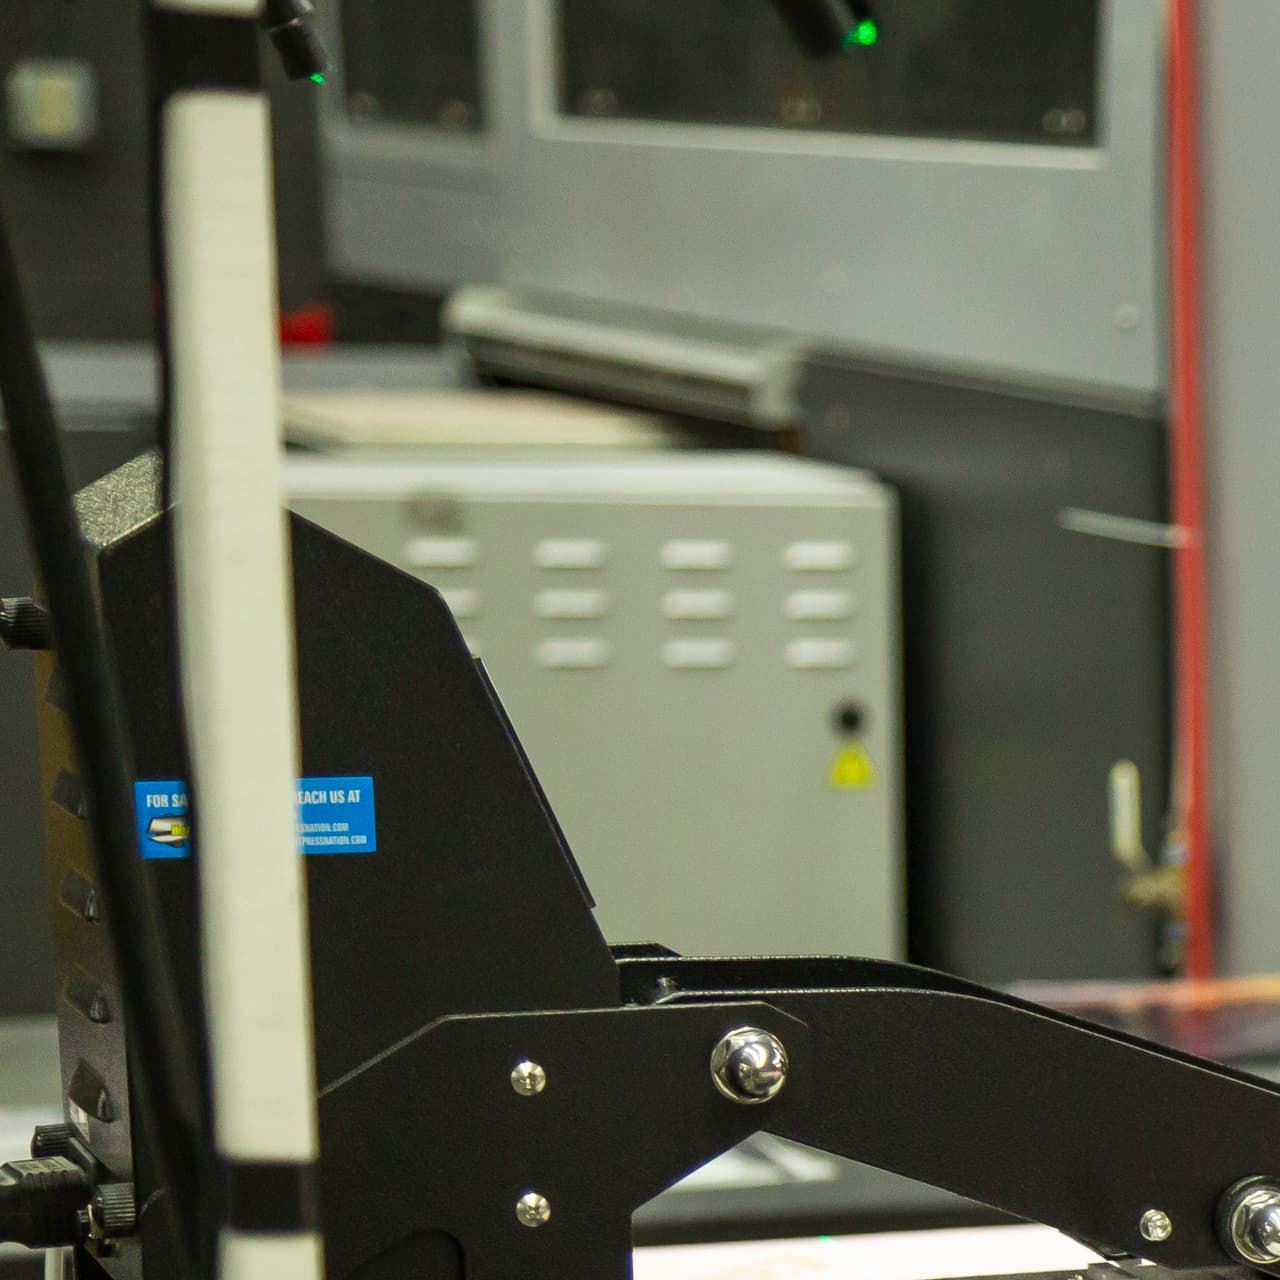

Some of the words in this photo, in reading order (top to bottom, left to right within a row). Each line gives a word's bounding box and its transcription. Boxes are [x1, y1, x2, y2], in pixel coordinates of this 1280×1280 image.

[146, 794, 169, 808] FOR
[330, 790, 345, 804] US
[347, 789, 361, 803] AT
